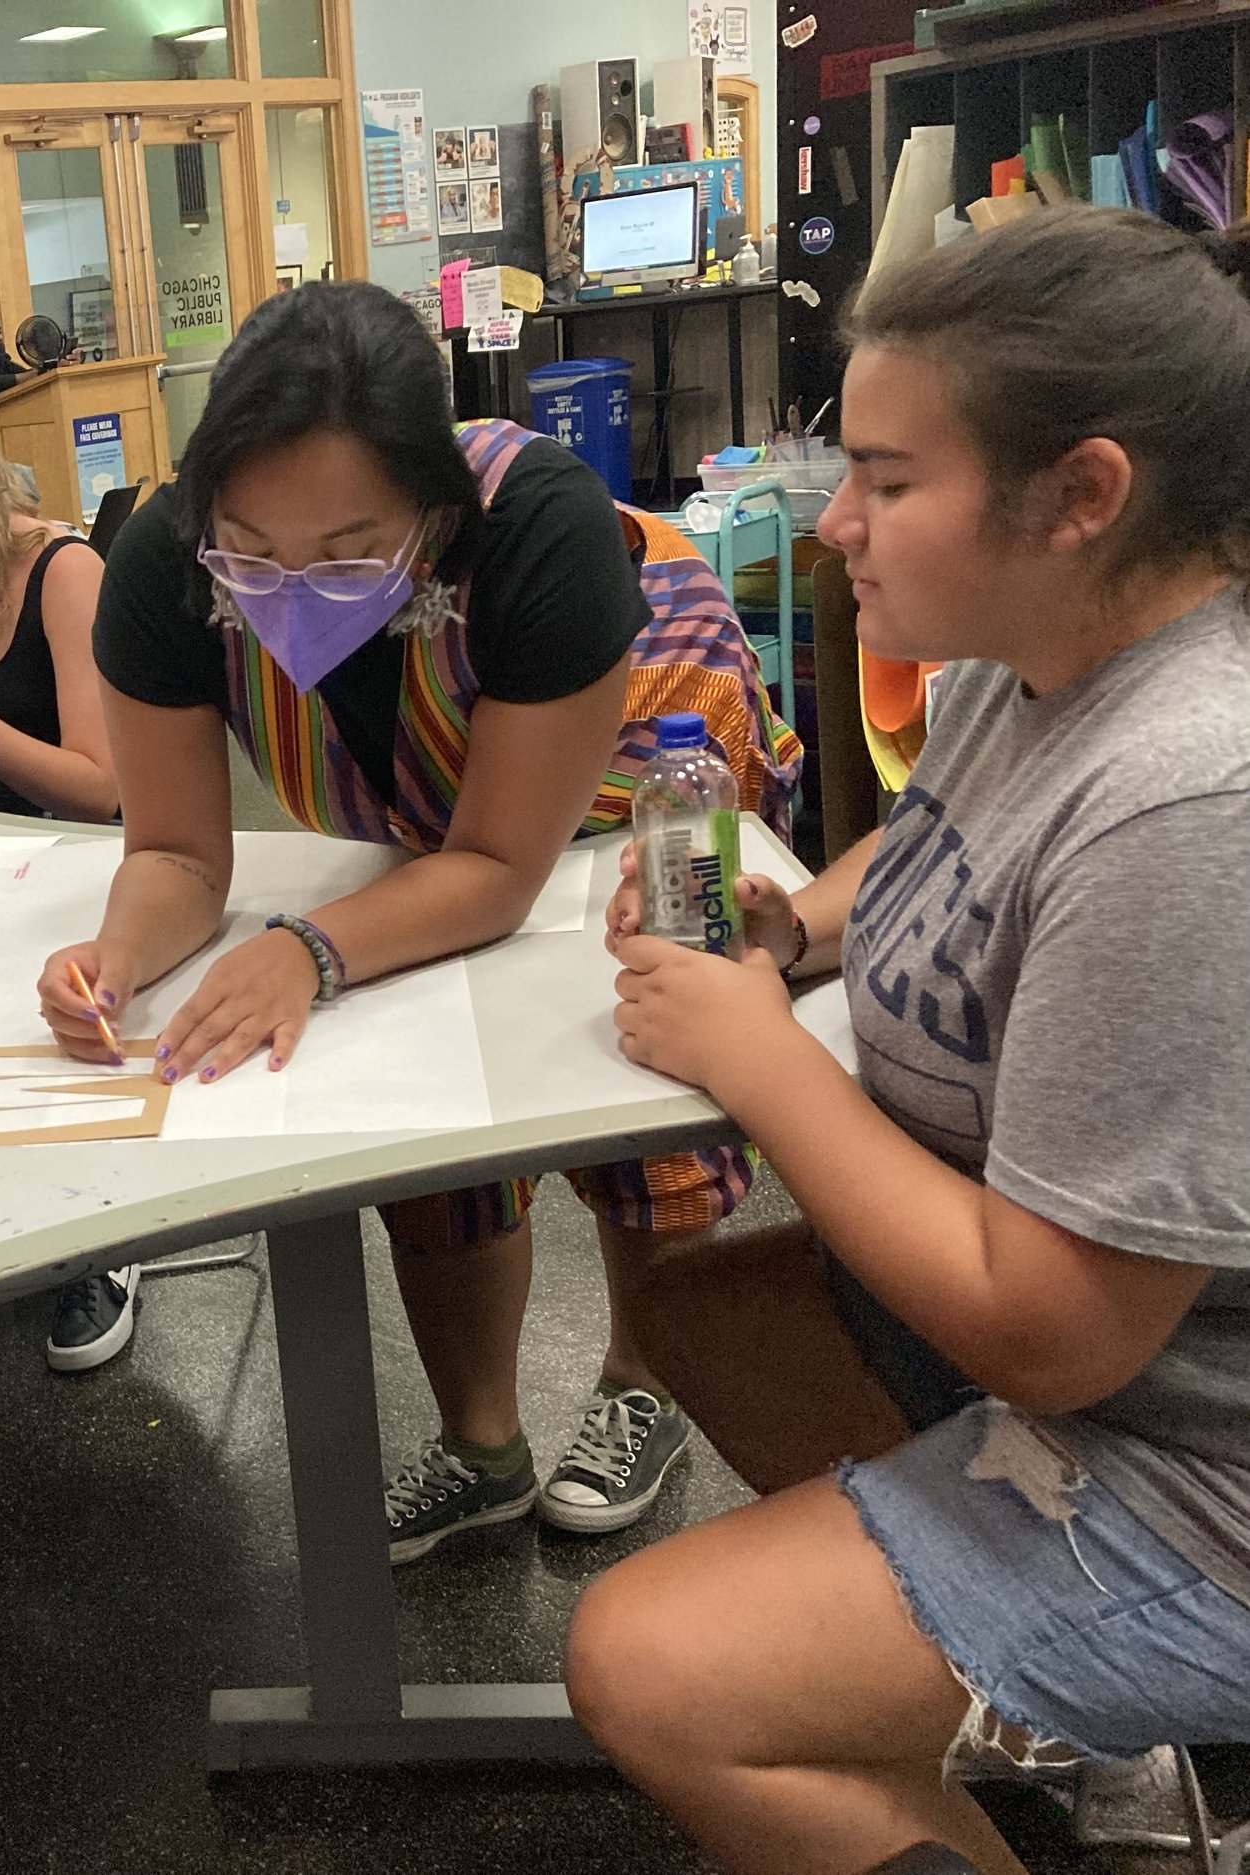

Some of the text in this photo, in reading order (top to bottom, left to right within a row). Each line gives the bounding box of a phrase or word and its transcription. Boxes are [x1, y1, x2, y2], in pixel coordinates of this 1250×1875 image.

[801, 148, 810, 190] kershaw
[803, 227, 831, 241] TAP
[81, 420, 113, 433] PLEASE WEAR
[79, 429, 118, 442] FACE COVERINGS
[690, 853, 733, 956] gchill
